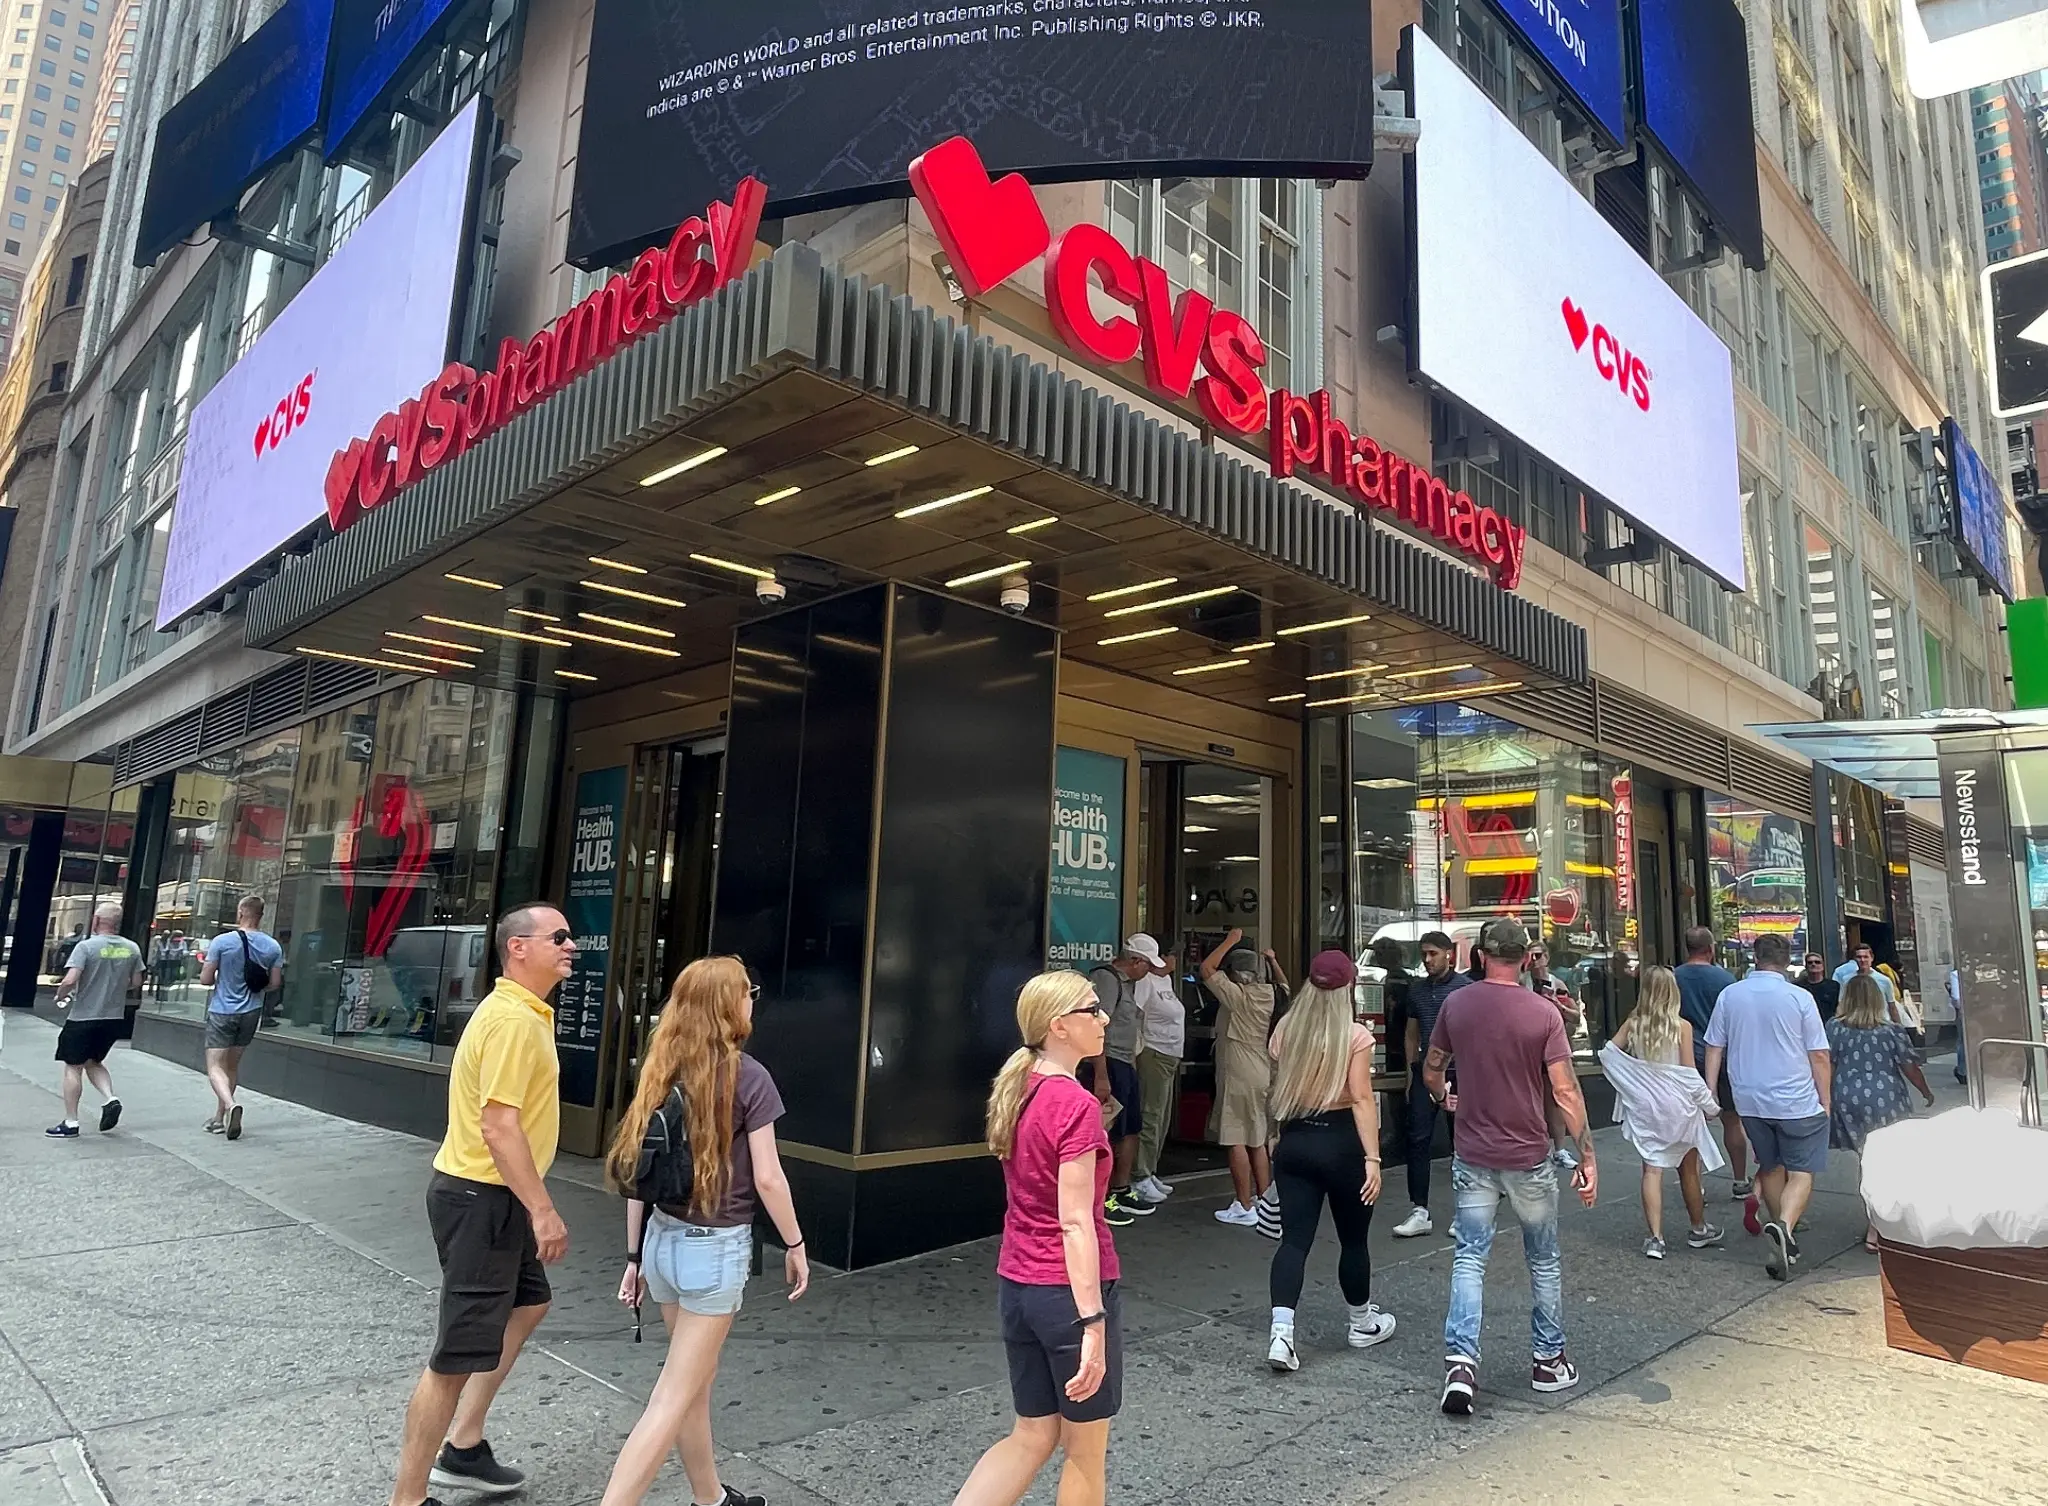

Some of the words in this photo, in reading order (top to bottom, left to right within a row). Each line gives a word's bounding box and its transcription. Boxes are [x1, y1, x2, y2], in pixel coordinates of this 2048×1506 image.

[646, 93, 687, 118] indicia
[691, 85, 713, 103] are
[762, 58, 817, 82] Warner
[866, 30, 987, 60] Entertainment
[995, 24, 1023, 40] Inc.
[1031, 15, 1129, 36] Publishing
[1135, 12, 1194, 32] Rights
[659, 53, 738, 92] WIZARDING
[743, 37, 799, 65] WORLD
[803, 29, 833, 49] and
[836, 24, 855, 43] all
[860, 11, 918, 37] related
[923, 1, 1027, 26] trademarks,
[358, 362, 476, 509] CVS
[460, 175, 768, 454] pharmacy
[1044, 223, 1267, 435] CVS
[1270, 388, 1525, 589] pharmacy
[576, 815, 614, 840] Health
[1053, 787, 1080, 801] lcome
[1954, 769, 1987, 885] Newsstand
[1049, 942, 1114, 961] ealthHUB
